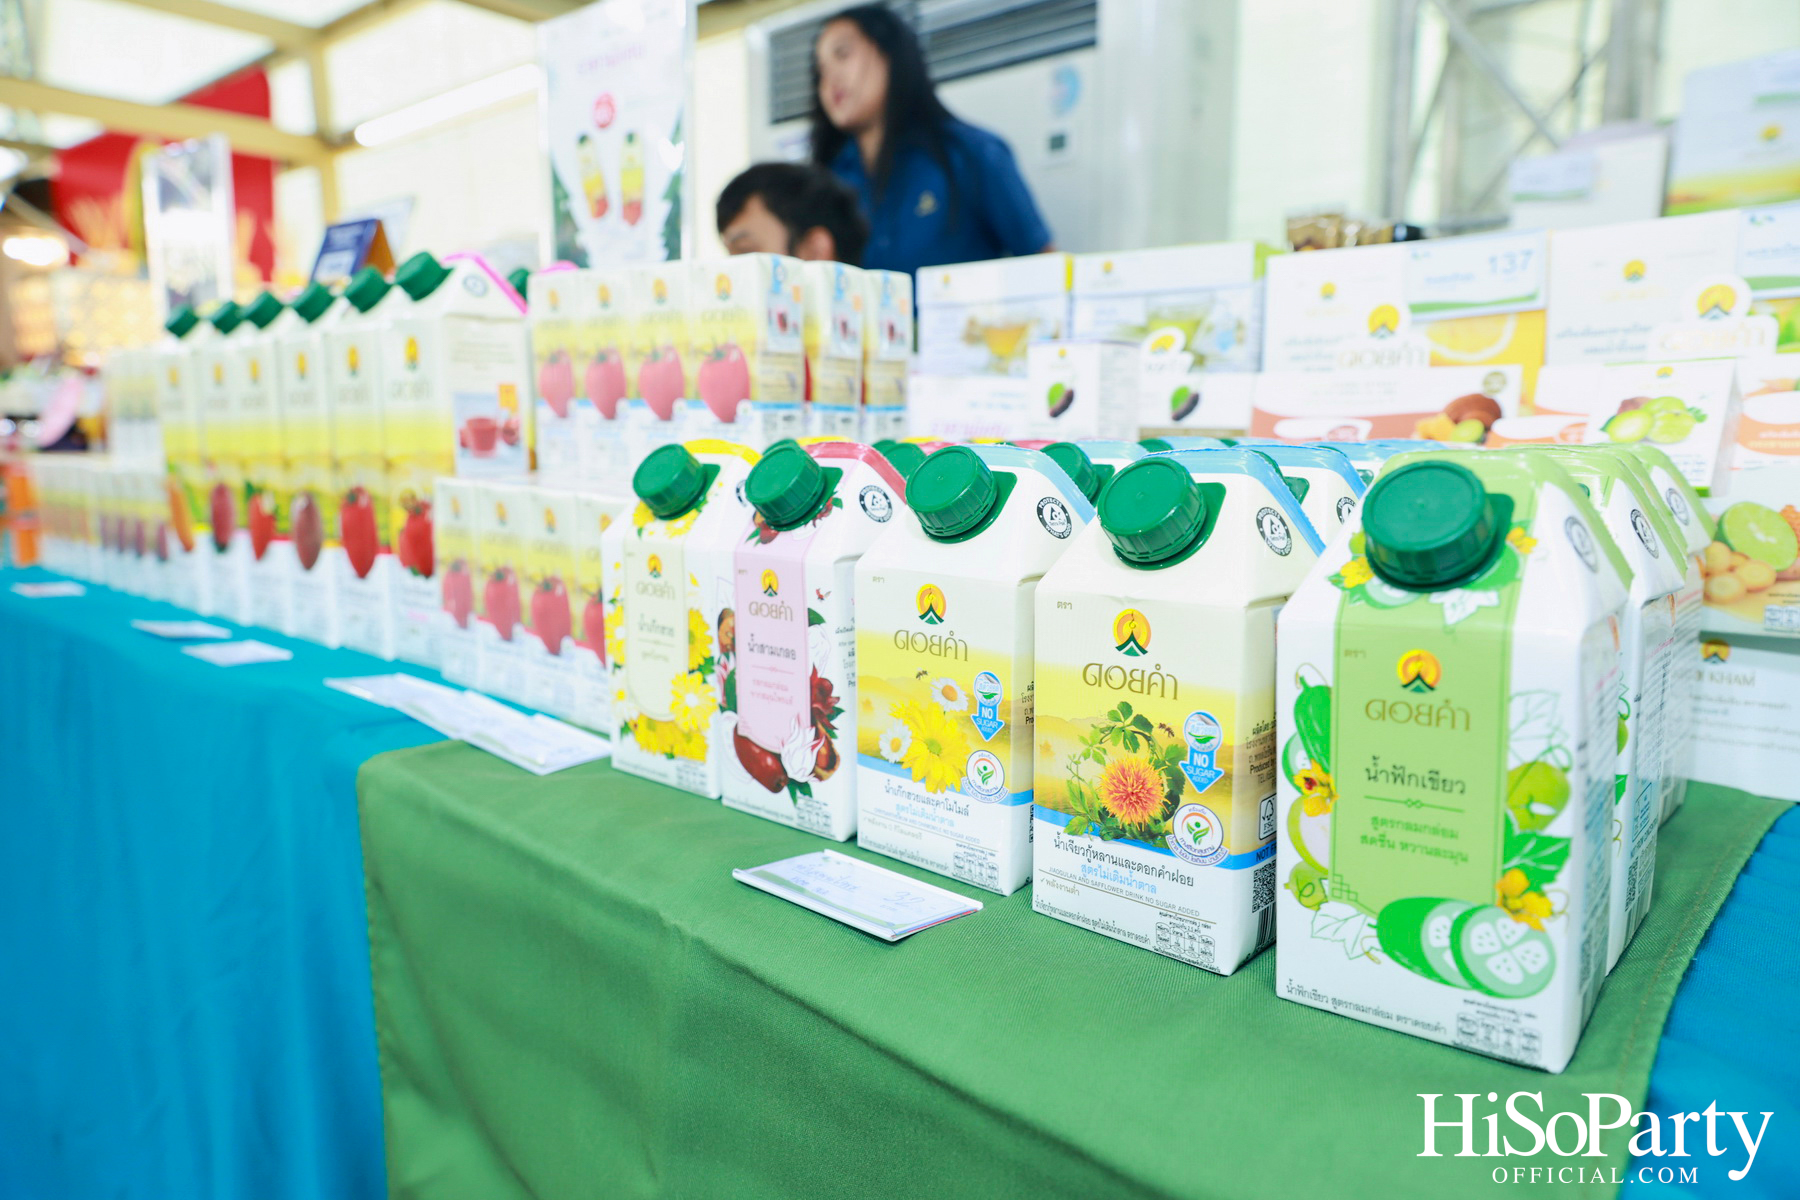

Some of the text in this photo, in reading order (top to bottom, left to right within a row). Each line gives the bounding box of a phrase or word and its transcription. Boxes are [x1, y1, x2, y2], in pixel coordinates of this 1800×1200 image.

[749, 600, 793, 622] ดอยคำ
[1057, 600, 1073, 610] ตรา
[894, 629, 968, 662] ดอยคำ
[1082, 662, 1178, 701] ดอยคำ
[976, 717, 998, 729] SUGAR
[981, 706, 993, 718] NO
[1364, 698, 1471, 731] ดอยคำ
[1186, 765, 1216, 779] SUGAR
[1193, 752, 1209, 768] NO
[1365, 755, 1467, 796] น้ำฟักเขียว
[884, 779, 970, 816] น้ำเก๊กฮวยและคาโมไมล์
[1370, 815, 1459, 840] สูตรกลมกล่อม
[1053, 831, 1195, 888] น้ำเจียวกู้หลานและดอกคำฝอย
[1256, 846, 1270, 862] NOT
[1080, 863, 1158, 895] สูตรไม่เติมน้ำตาล
[1078, 874, 1090, 885] AND
[1091, 878, 1124, 896] SAFFLOWER
[1125, 889, 1144, 901] DRINK
[1145, 896, 1155, 905] NO
[1155, 899, 1177, 912] SUGAR
[1178, 905, 1200, 918] ADDED
[1286, 978, 1329, 1005] น้ำฟักเขียว
